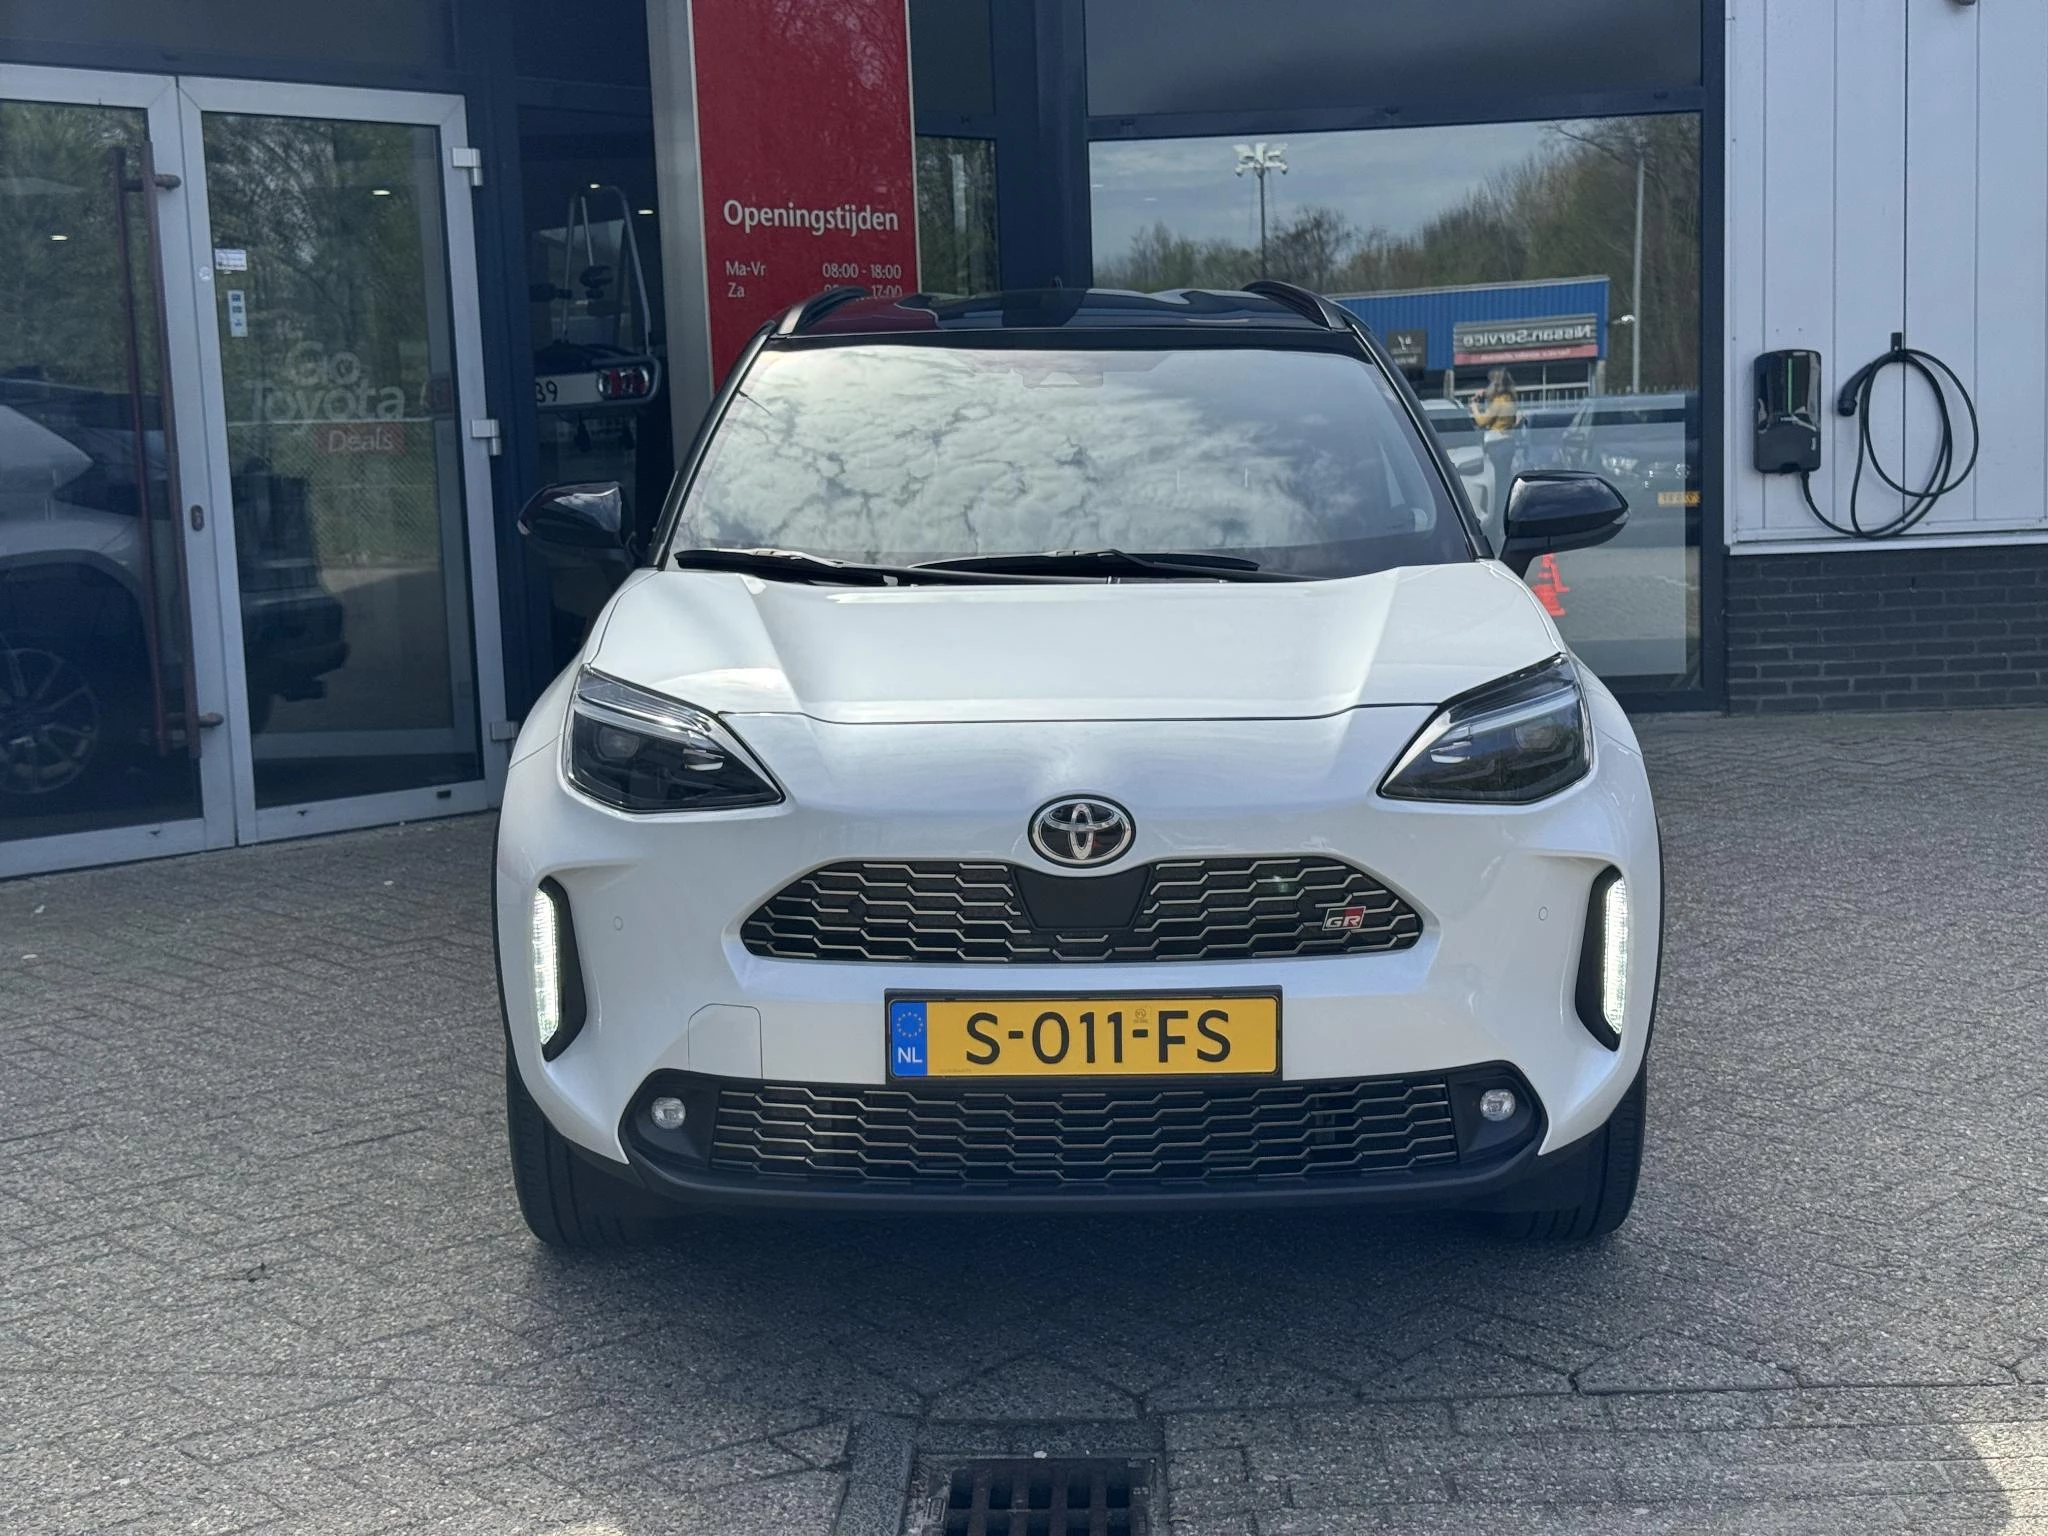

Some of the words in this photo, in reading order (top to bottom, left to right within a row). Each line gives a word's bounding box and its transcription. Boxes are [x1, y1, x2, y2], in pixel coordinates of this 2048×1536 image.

[723, 200, 899, 237] Openingstijden
[725, 260, 766, 277] Ma-Vr
[822, 263, 859, 278] 08:00
[870, 264, 902, 279] 18:00
[728, 282, 745, 298] Za
[285, 340, 361, 385] Go
[245, 377, 405, 422] Toyota
[328, 428, 394, 451] Deals
[1325, 915, 1362, 928] GR
[966, 1010, 1231, 1065] S-011-FS
[897, 1046, 923, 1064] NL
